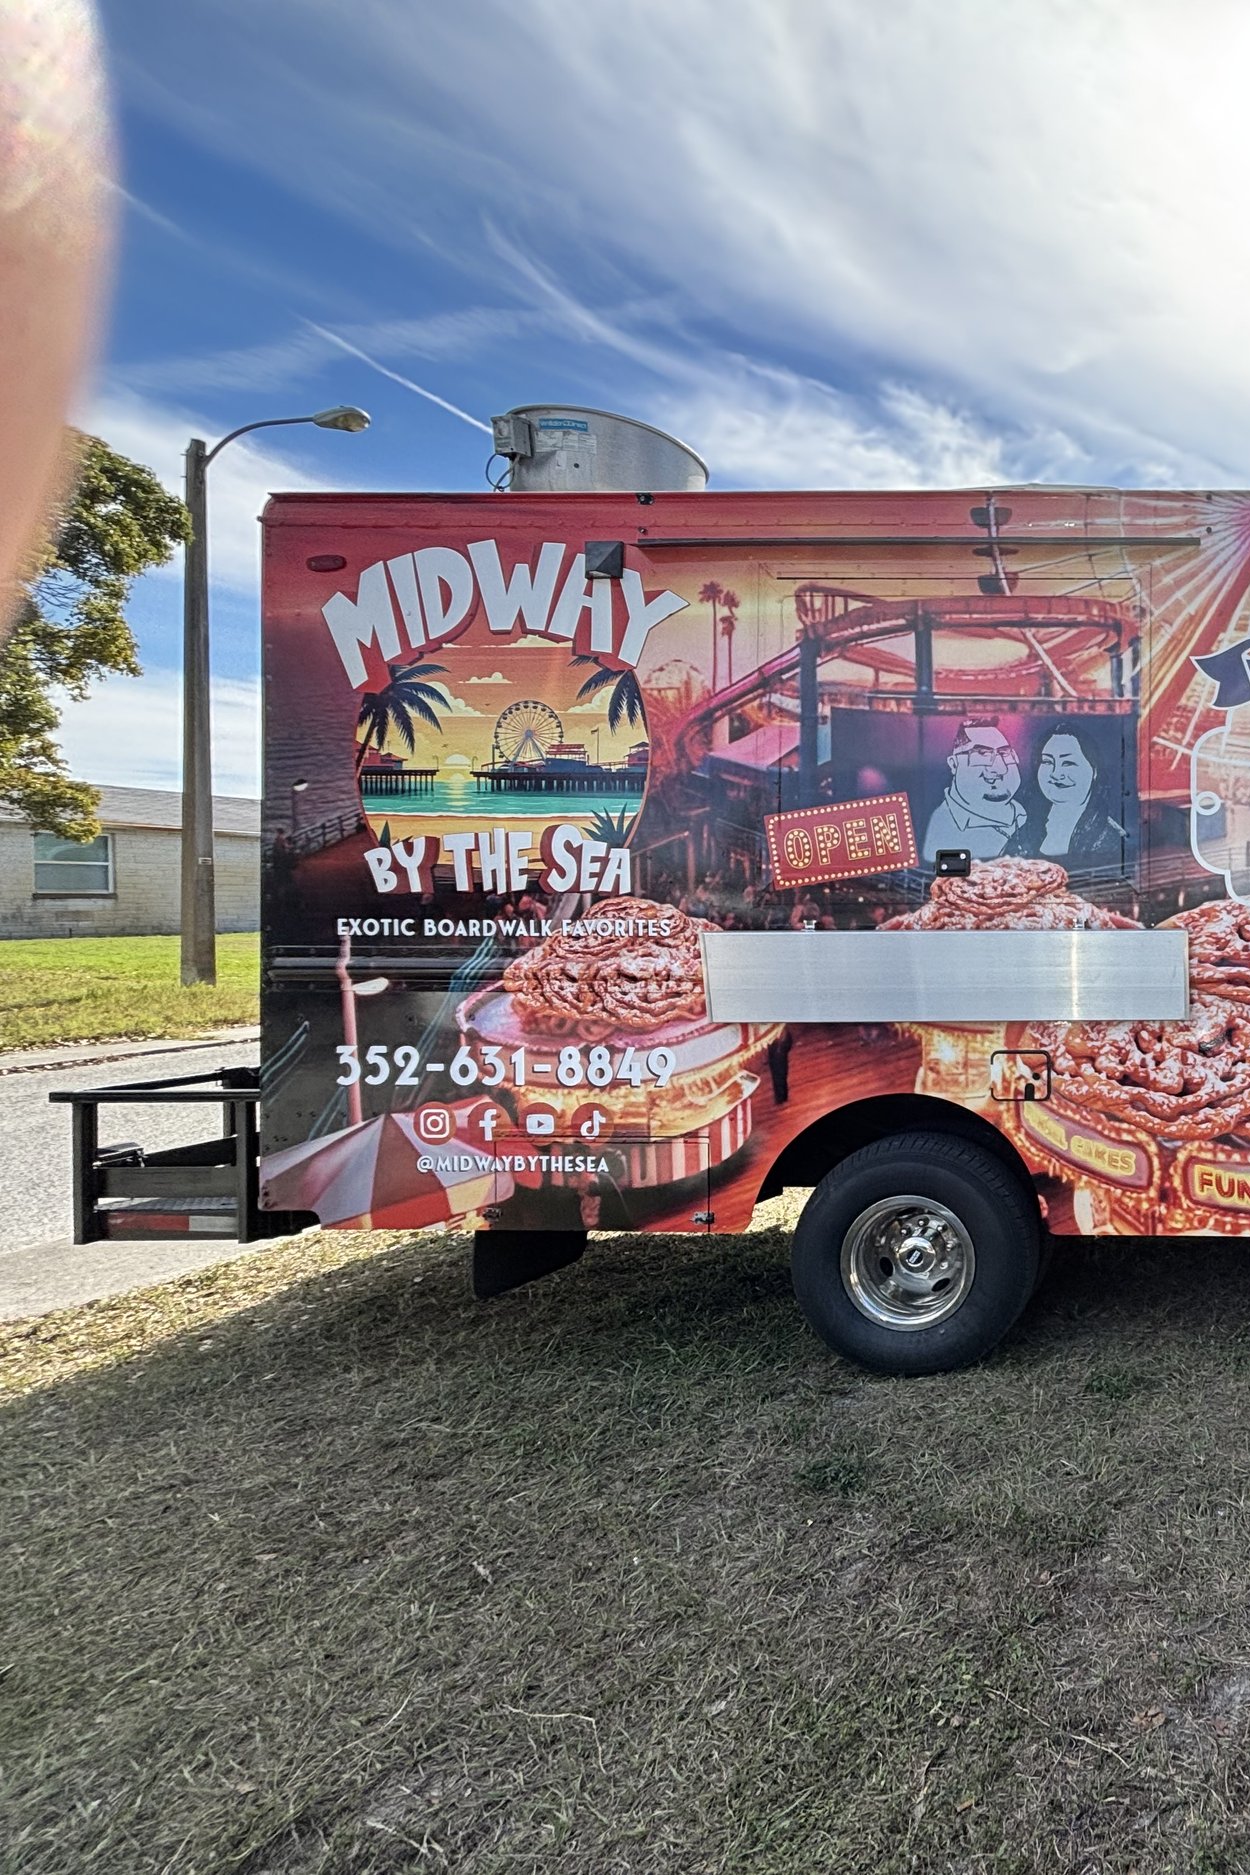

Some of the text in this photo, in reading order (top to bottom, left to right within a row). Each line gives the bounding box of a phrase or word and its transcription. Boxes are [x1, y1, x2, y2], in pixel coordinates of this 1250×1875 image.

[321, 539, 691, 690] MIDWAY
[364, 824, 631, 895] BY THE SEA
[784, 812, 903, 869] OPEN
[337, 918, 672, 938] EXOTIC BOARDWALK FAVORITES
[335, 1045, 678, 1088] 352-631-8849
[416, 1155, 610, 1174] @MIDWAYBYTHESEA
